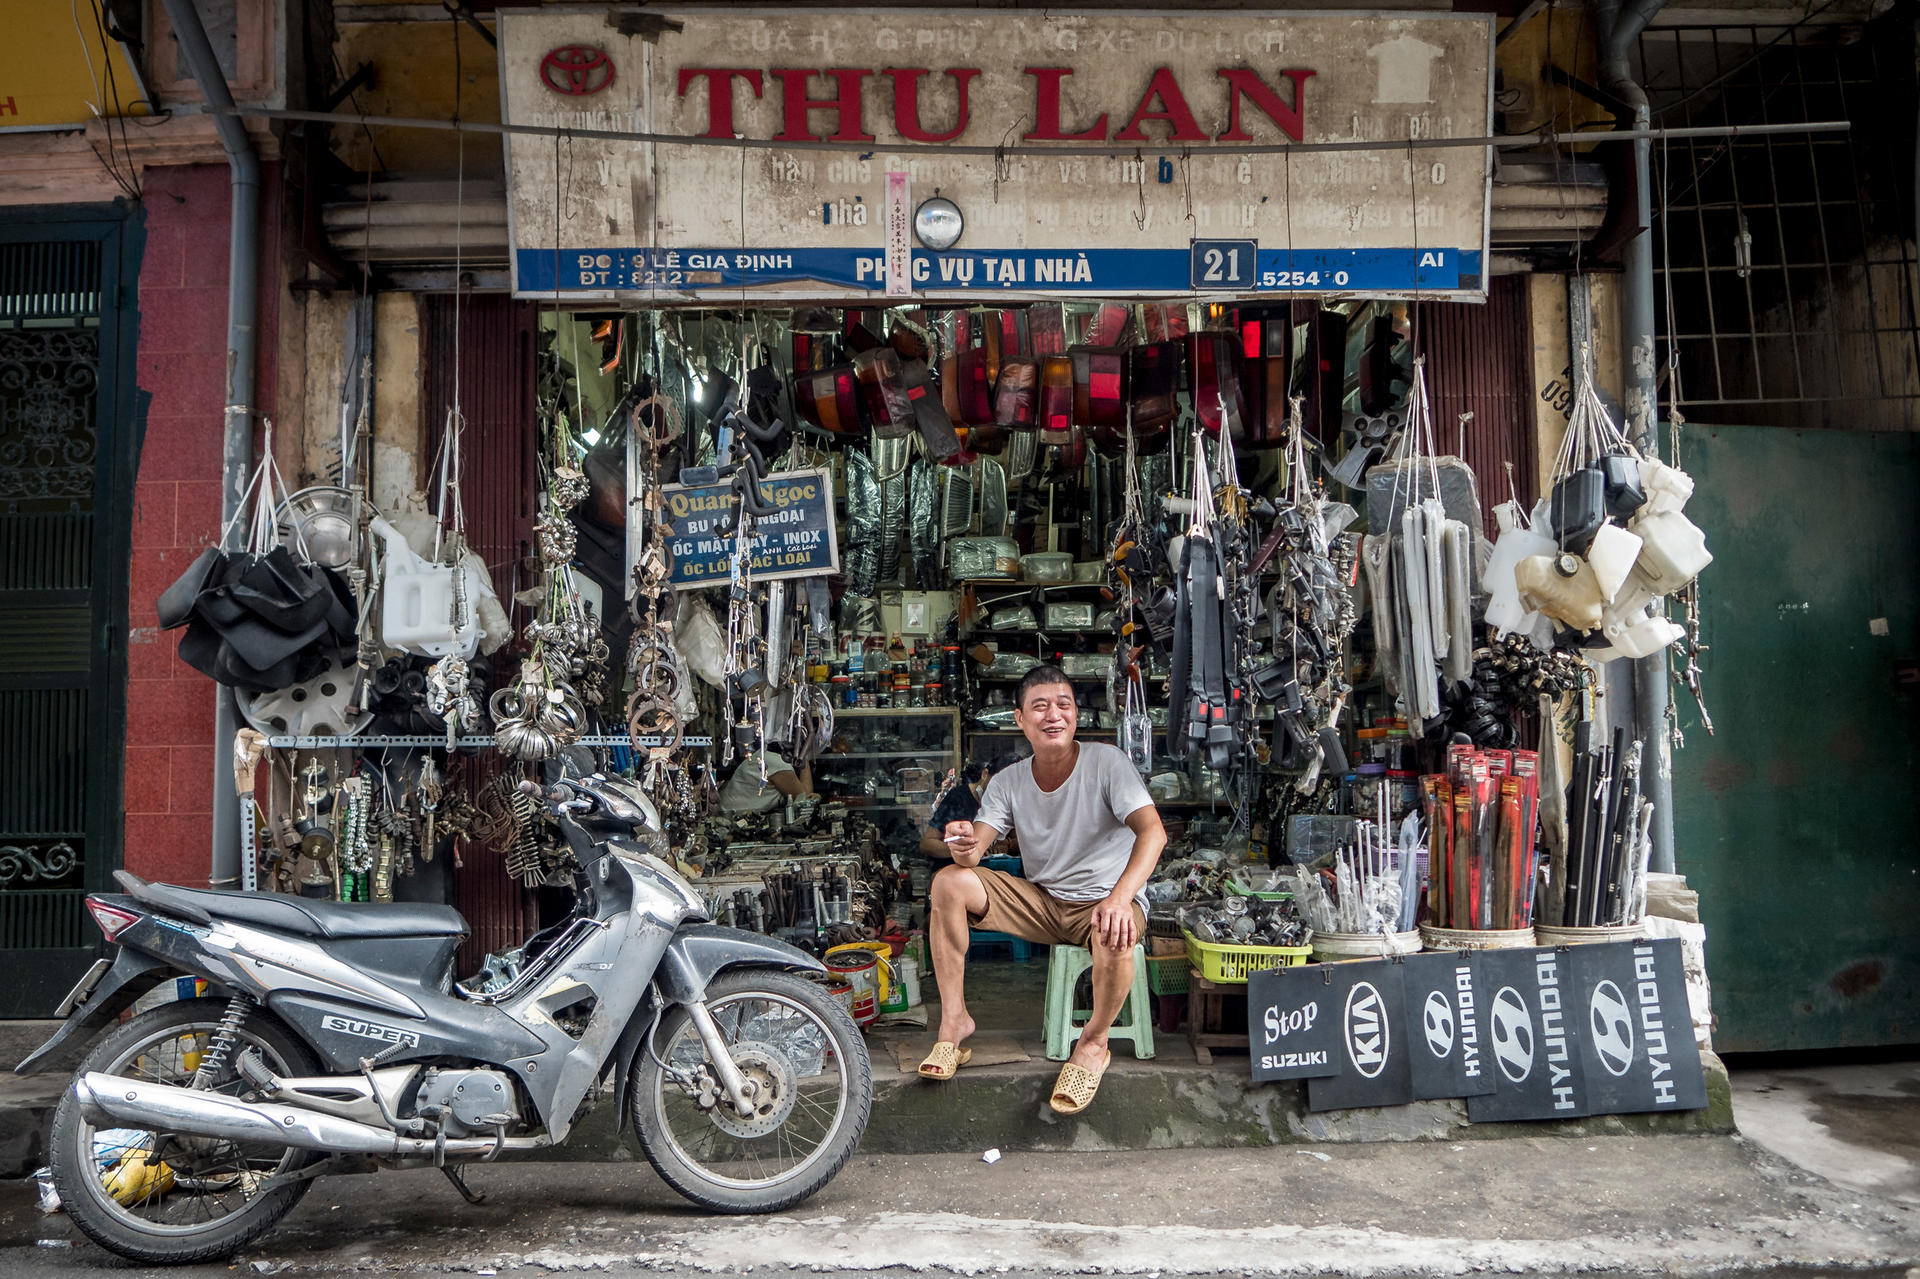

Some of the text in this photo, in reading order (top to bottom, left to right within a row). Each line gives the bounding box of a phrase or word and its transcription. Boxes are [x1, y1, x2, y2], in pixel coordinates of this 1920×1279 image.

[678, 66, 1317, 143] THU LAN
[579, 271, 610, 285] ĐT
[651, 251, 681, 268] LÊ
[688, 254, 729, 269] GIA
[735, 254, 793, 272] ĐỊNH
[856, 252, 1093, 287] PHC VỤ TẠI NHÀ
[1203, 249, 1240, 281] 21
[670, 484, 816, 518] Quan Ngọc
[673, 538, 693, 556] ỐC
[784, 530, 821, 545] INOX
[687, 519, 709, 534] BU
[683, 559, 704, 576] ỐC
[776, 552, 811, 566] LOẠI
[329, 1018, 416, 1045] SUPER
[1263, 1001, 1318, 1045] Stop
[1351, 994, 1383, 1065] KIA
[1455, 966, 1481, 1077] HYUNDAI
[1536, 952, 1576, 1110] HYUNDAI
[1633, 946, 1677, 1104] HYUNDAI
[1261, 1050, 1328, 1070] SUZUKI
